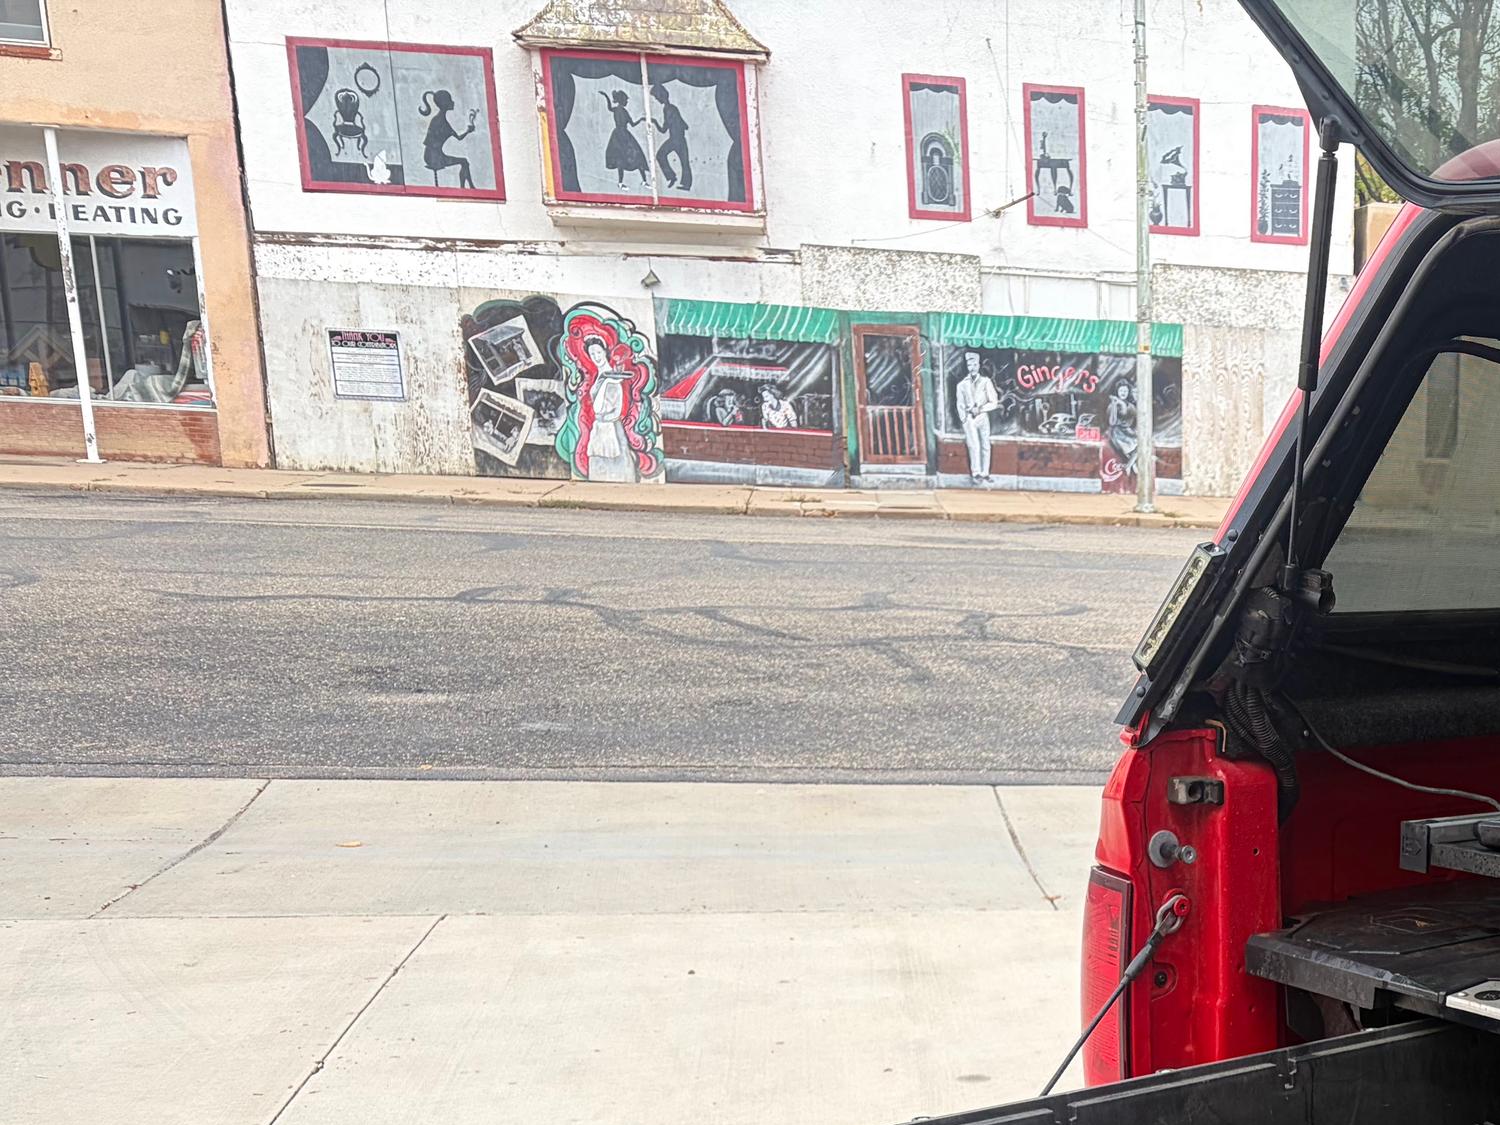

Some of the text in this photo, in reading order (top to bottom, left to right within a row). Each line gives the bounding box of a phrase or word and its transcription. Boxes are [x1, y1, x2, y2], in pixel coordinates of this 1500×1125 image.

[0, 160, 178, 199] nner
[0, 200, 27, 219] G
[1017, 364, 1099, 394] Gingers
